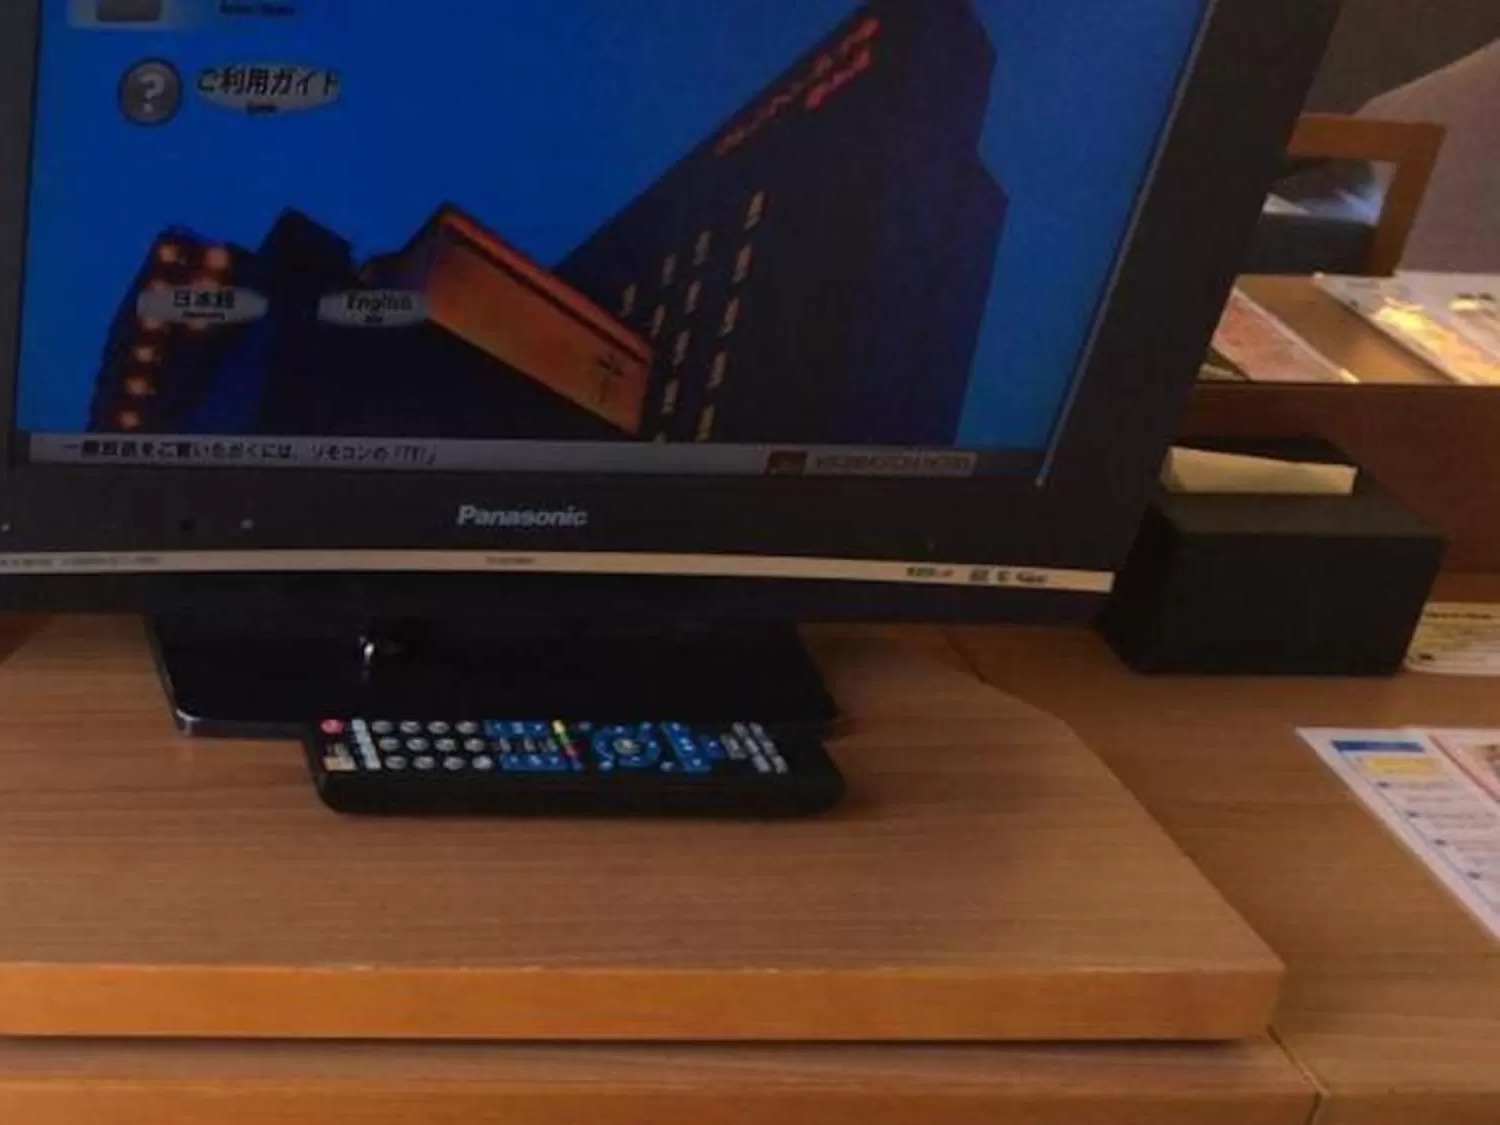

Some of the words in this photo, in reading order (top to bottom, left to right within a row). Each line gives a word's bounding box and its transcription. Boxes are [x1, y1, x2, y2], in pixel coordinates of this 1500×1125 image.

[197, 66, 338, 97] ご利用ガイド
[346, 291, 413, 312] English
[457, 503, 589, 526] Panasonic
